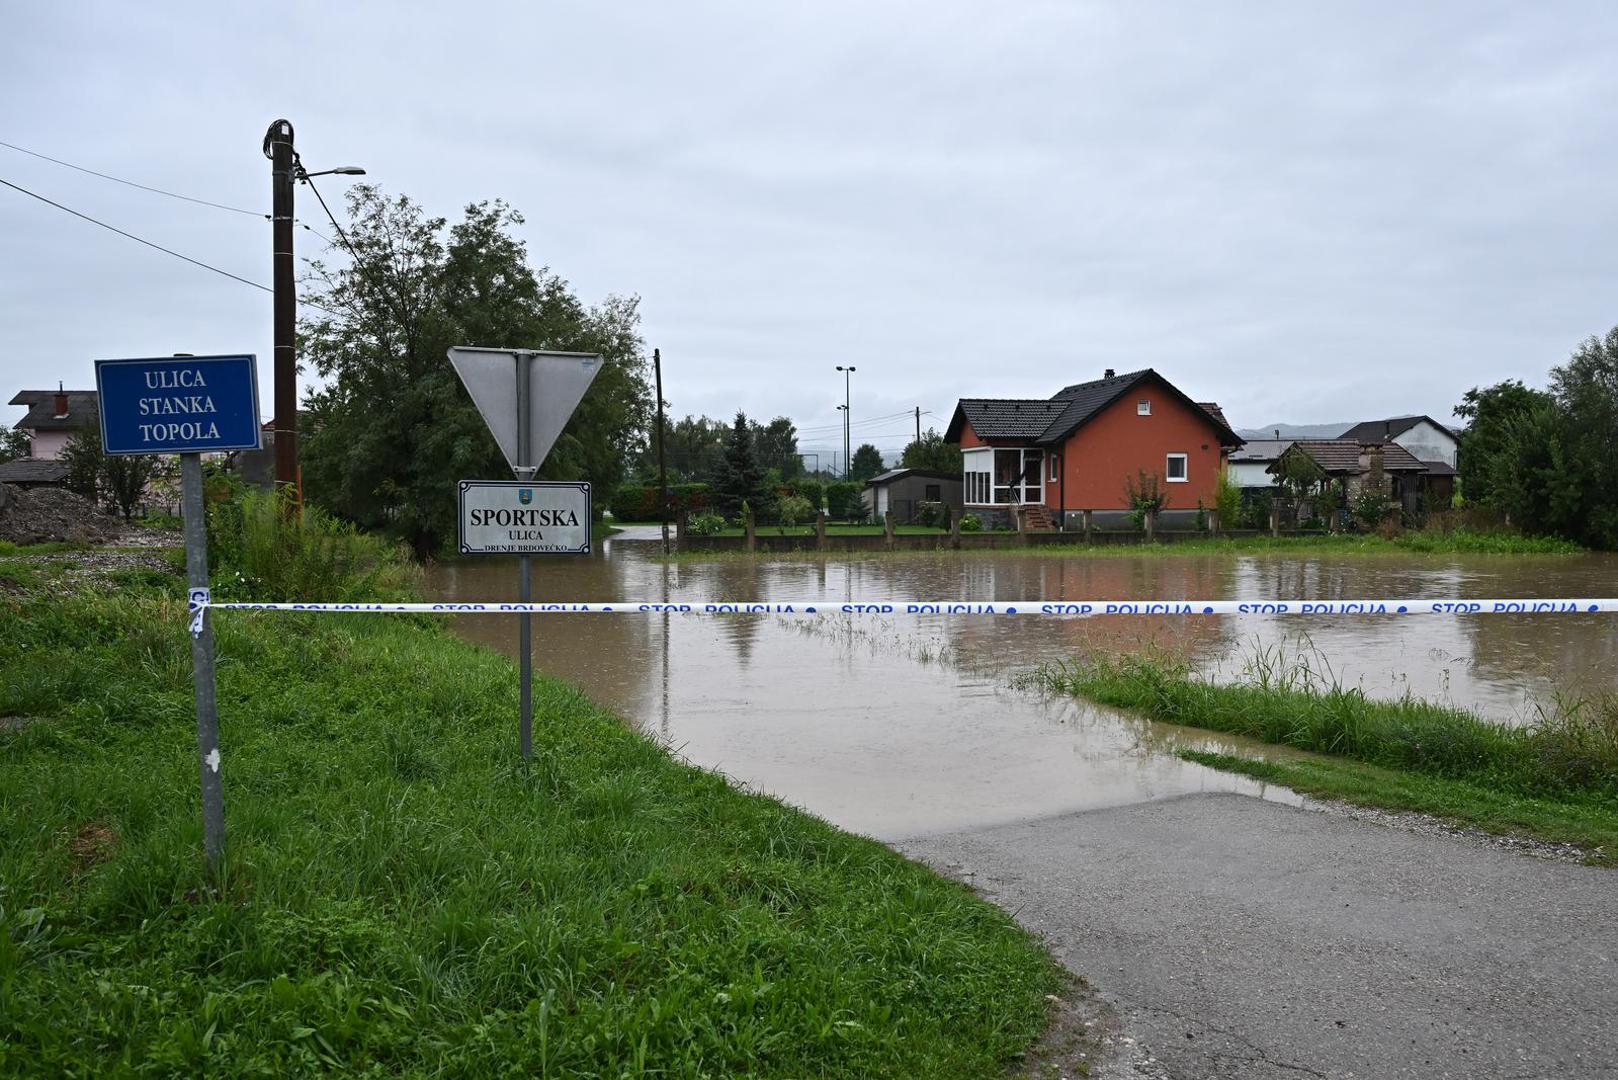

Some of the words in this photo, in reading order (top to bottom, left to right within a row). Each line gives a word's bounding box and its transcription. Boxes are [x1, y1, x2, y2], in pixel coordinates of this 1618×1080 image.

[144, 369, 207, 389] ULICA
[139, 396, 217, 415] STANKA
[139, 422, 221, 442] TOPOLA
[470, 509, 579, 526] SPORTSKA
[508, 530, 544, 541] ULICA
[485, 544, 517, 552] DRENJE
